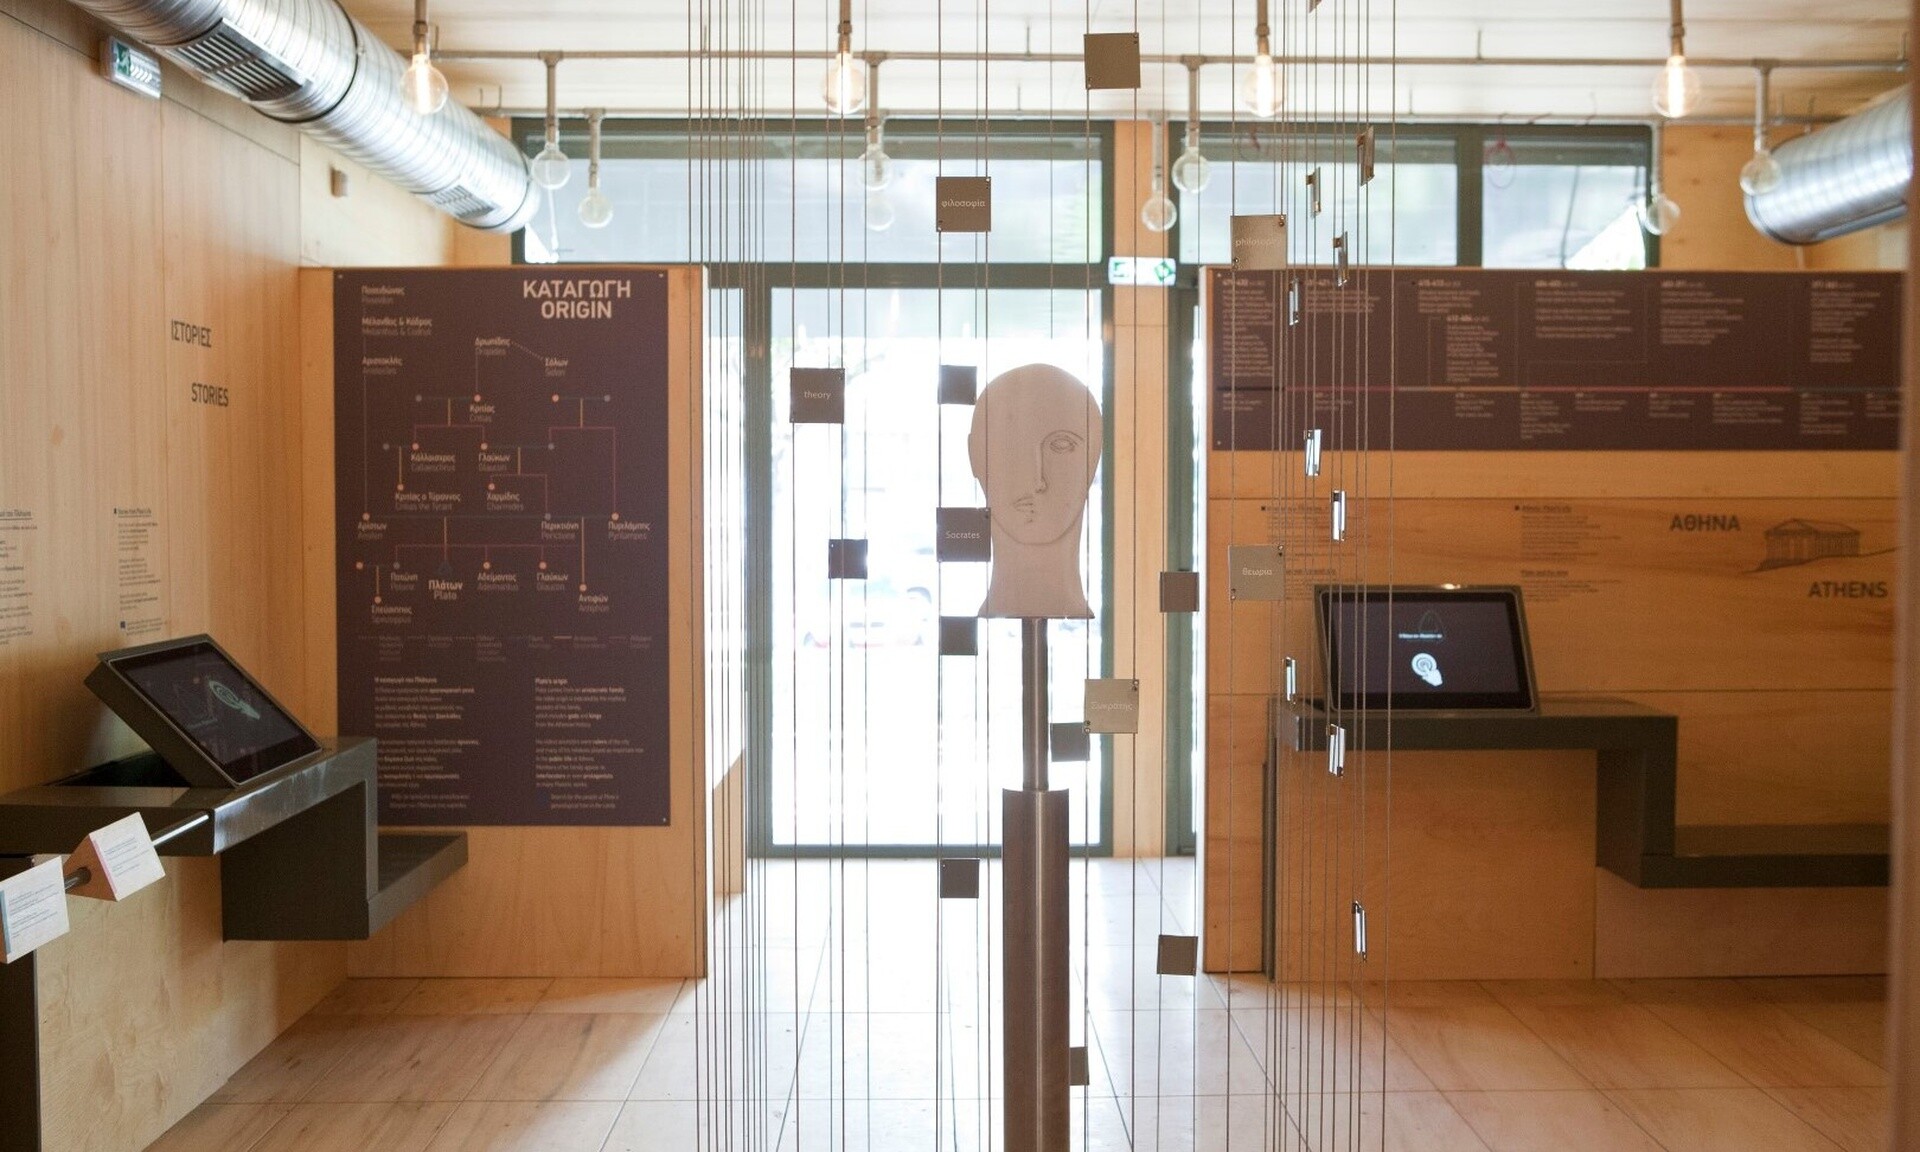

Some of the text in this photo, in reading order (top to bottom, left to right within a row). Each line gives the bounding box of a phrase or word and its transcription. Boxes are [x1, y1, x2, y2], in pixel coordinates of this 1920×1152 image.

[941, 195, 986, 209] φιλοσοφία
[523, 279, 631, 299] ΚΑΤΑΓΩΓΗ
[541, 300, 612, 319] ORIGIN
[171, 318, 212, 348] ΙΣΤΟΡΙΕΣ
[191, 381, 229, 407] STORIES
[804, 390, 831, 401] theory
[1669, 514, 1741, 532] ΑΘΗΝΑ
[945, 530, 981, 540] Socrates
[428, 579, 463, 590] Πλάτων
[1808, 580, 1888, 598] ATHENS
[433, 590, 457, 600] Plato
